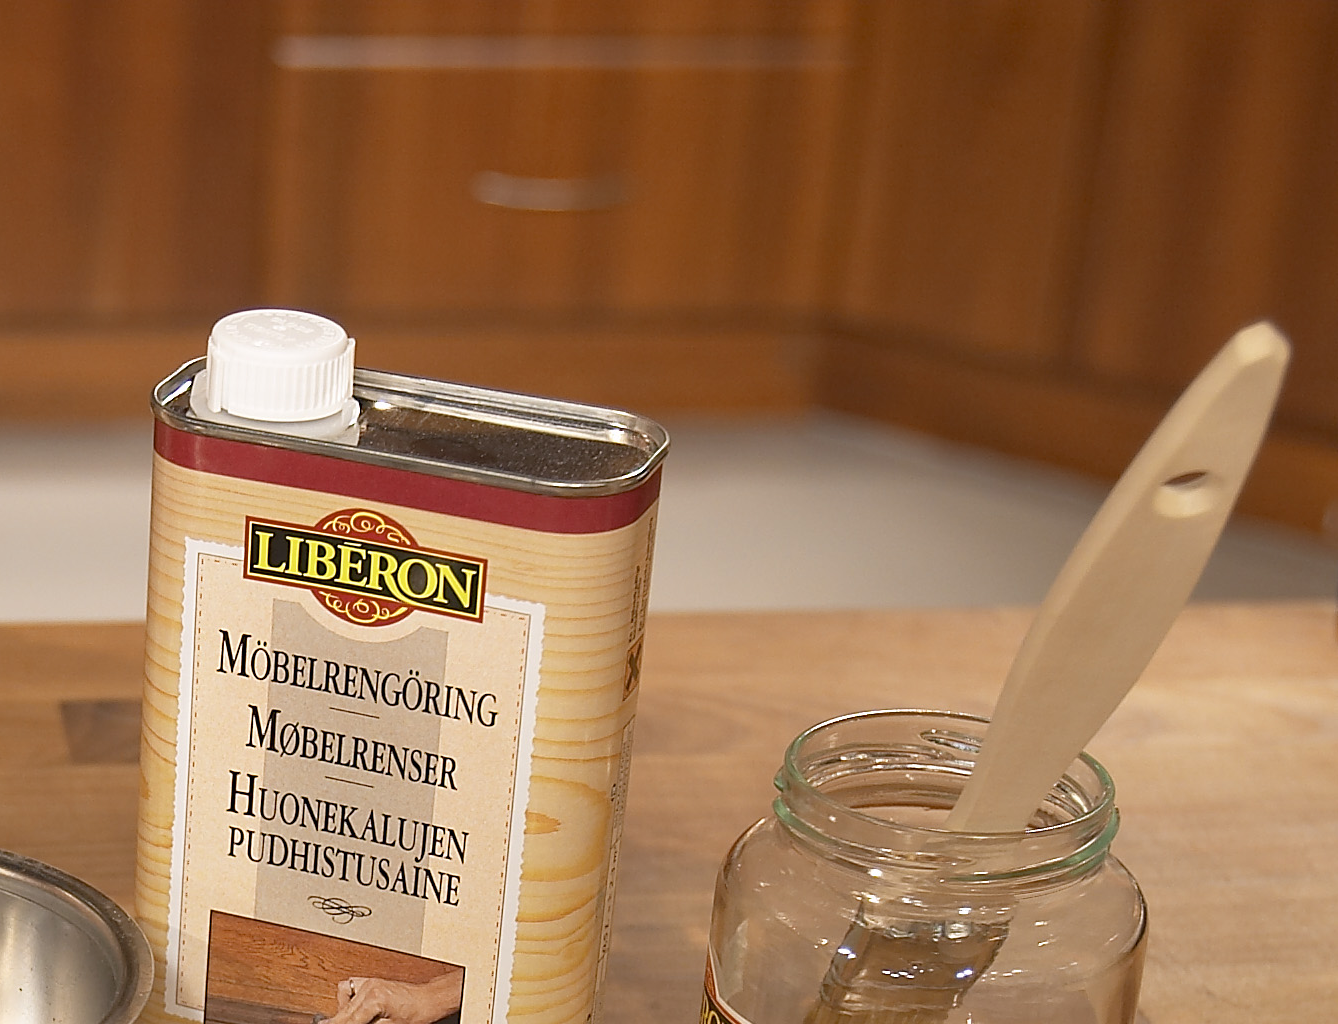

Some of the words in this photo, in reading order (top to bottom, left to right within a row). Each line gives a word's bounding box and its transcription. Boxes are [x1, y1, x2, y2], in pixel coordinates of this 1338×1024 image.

[216, 629, 499, 728] MÖBELRENGÖRING
[246, 704, 458, 791] MØBELRENSER
[226, 770, 469, 865] HUONEKALUJEN
[228, 826, 461, 906] PUDHISTUSAINE
